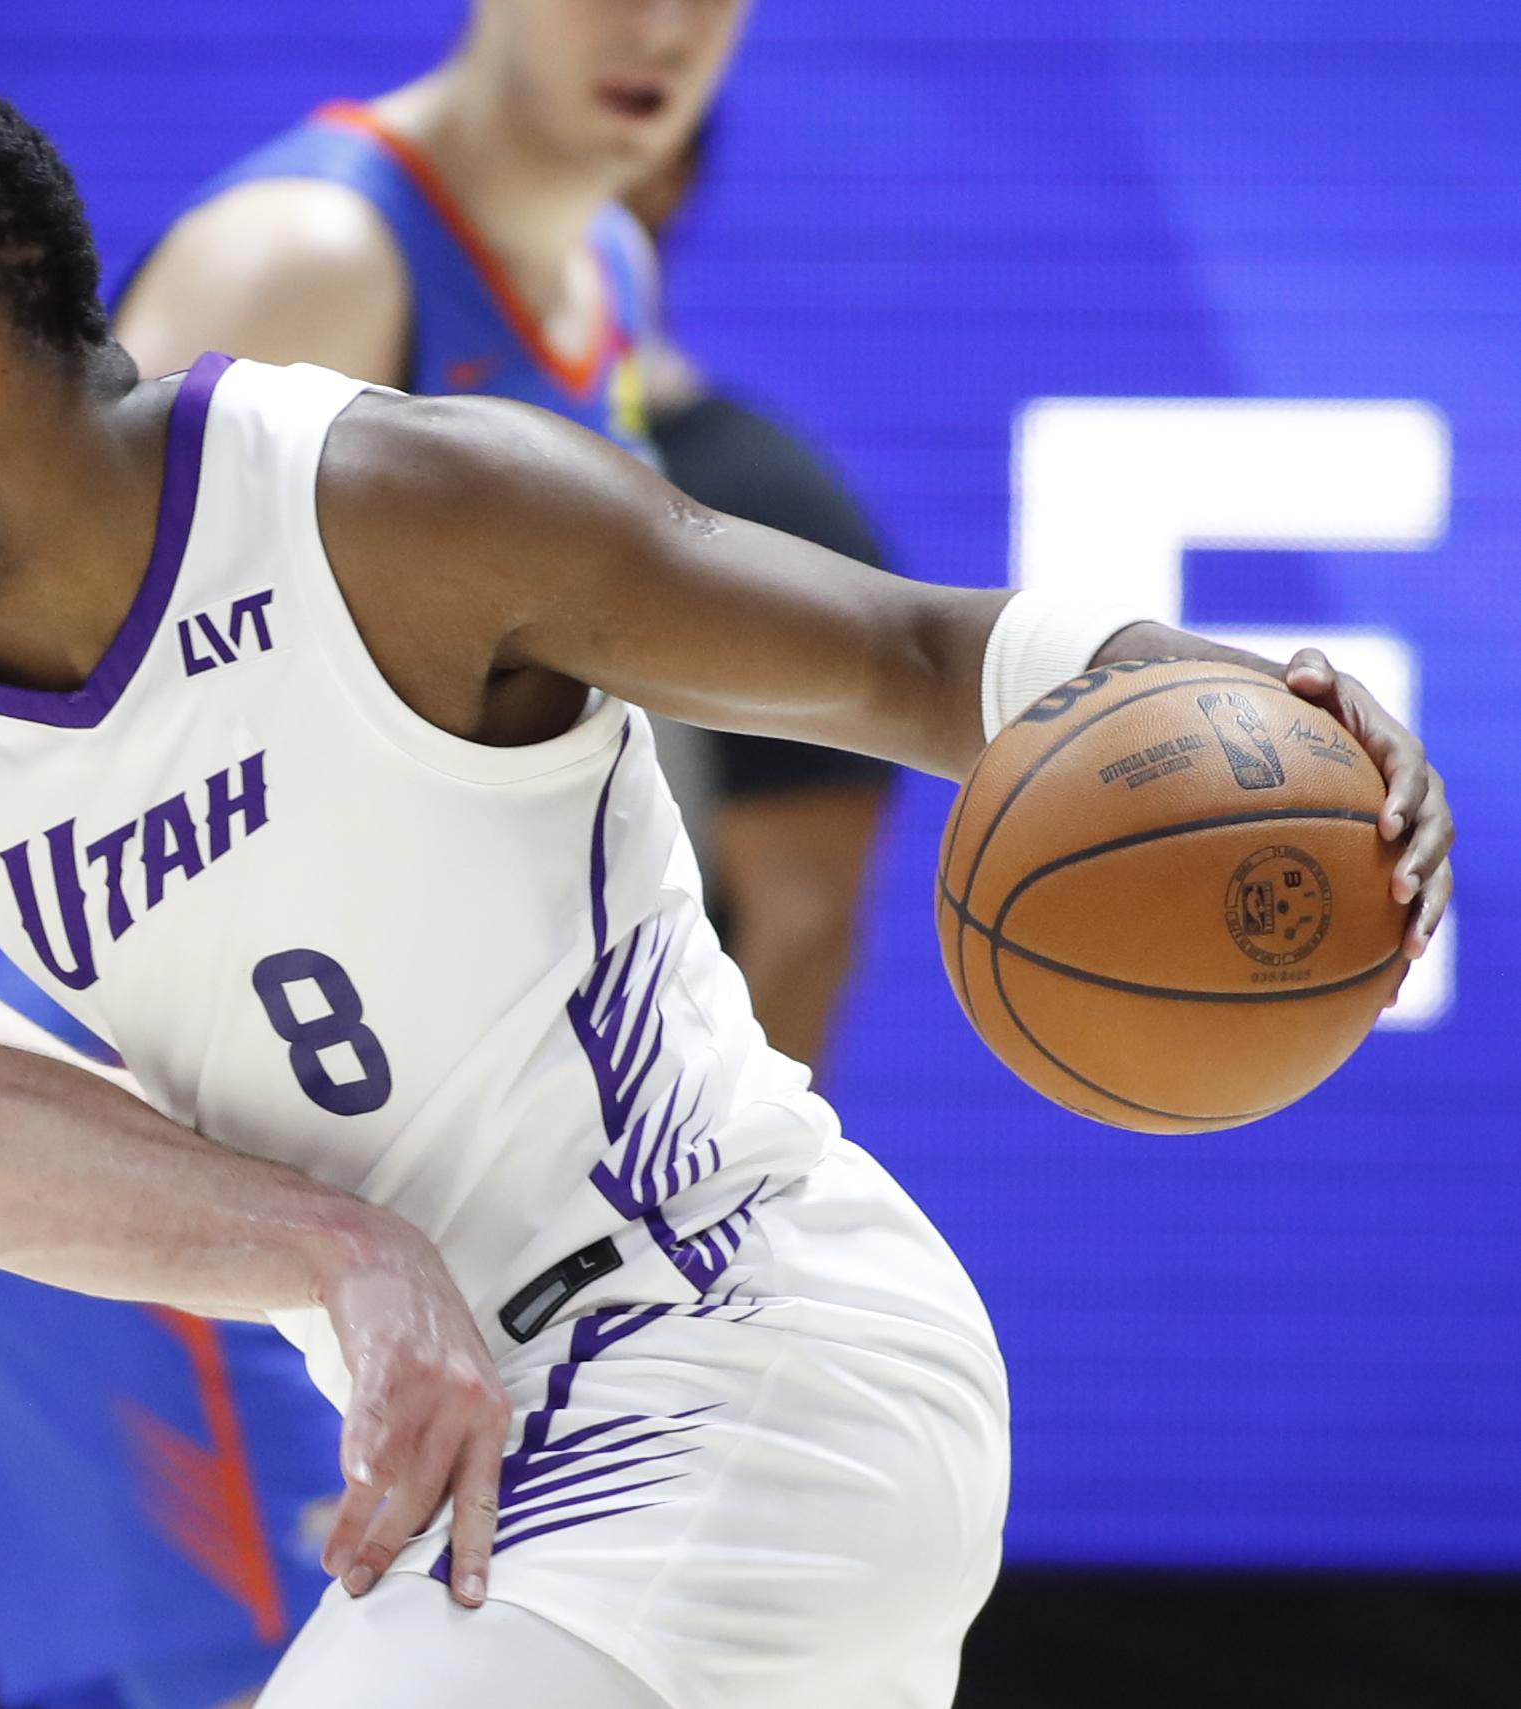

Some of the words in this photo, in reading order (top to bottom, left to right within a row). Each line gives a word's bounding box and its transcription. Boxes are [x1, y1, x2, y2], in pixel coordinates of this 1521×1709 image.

[177, 588, 275, 678] LVT
[1098, 751, 1147, 784] OFFICIAL
[1144, 739, 1178, 763] GAME
[1175, 733, 1206, 753] BALL
[251, 947, 391, 1116] 8
[578, 1256, 597, 1270] L
